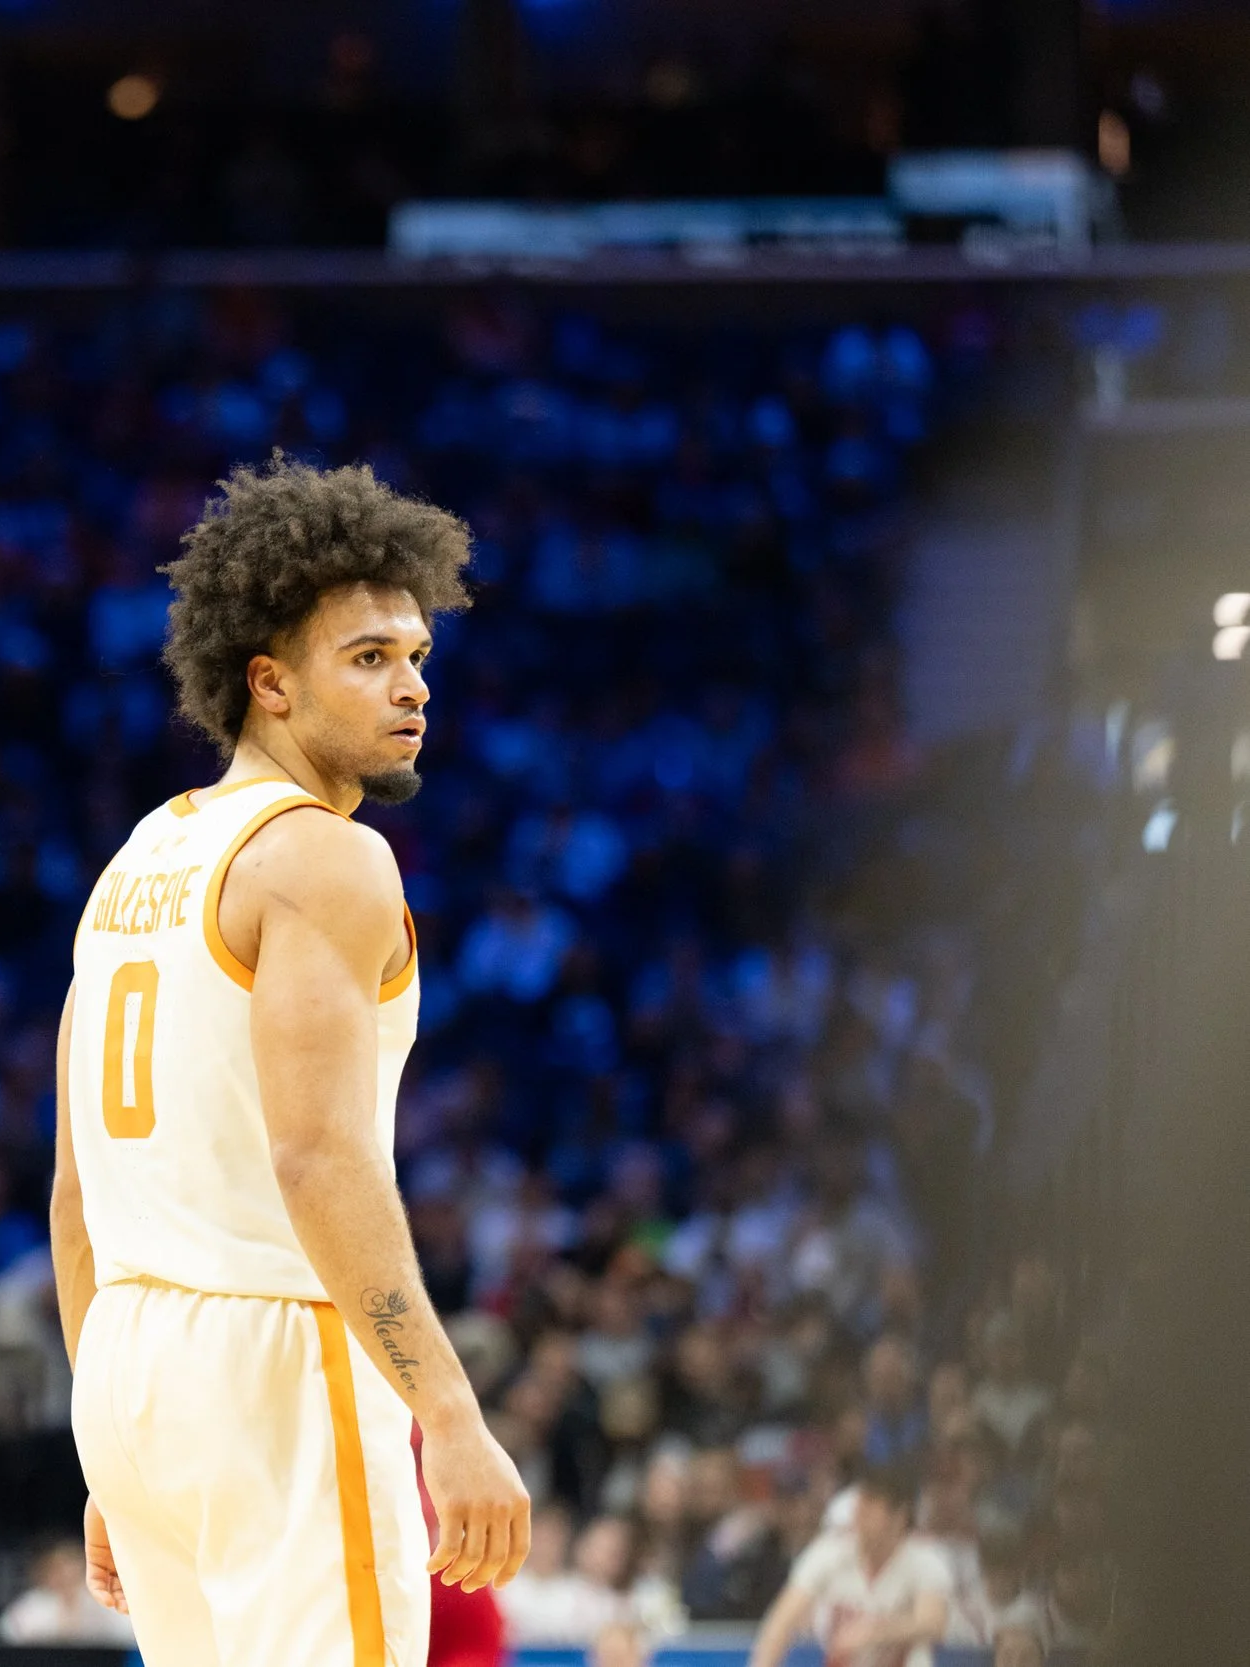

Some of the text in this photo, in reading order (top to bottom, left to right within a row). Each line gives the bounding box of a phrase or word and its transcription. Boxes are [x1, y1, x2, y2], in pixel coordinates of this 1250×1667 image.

[93, 865, 203, 936] GILLESPIE
[102, 960, 160, 1140] 0
[360, 1287, 420, 1394] Heather
